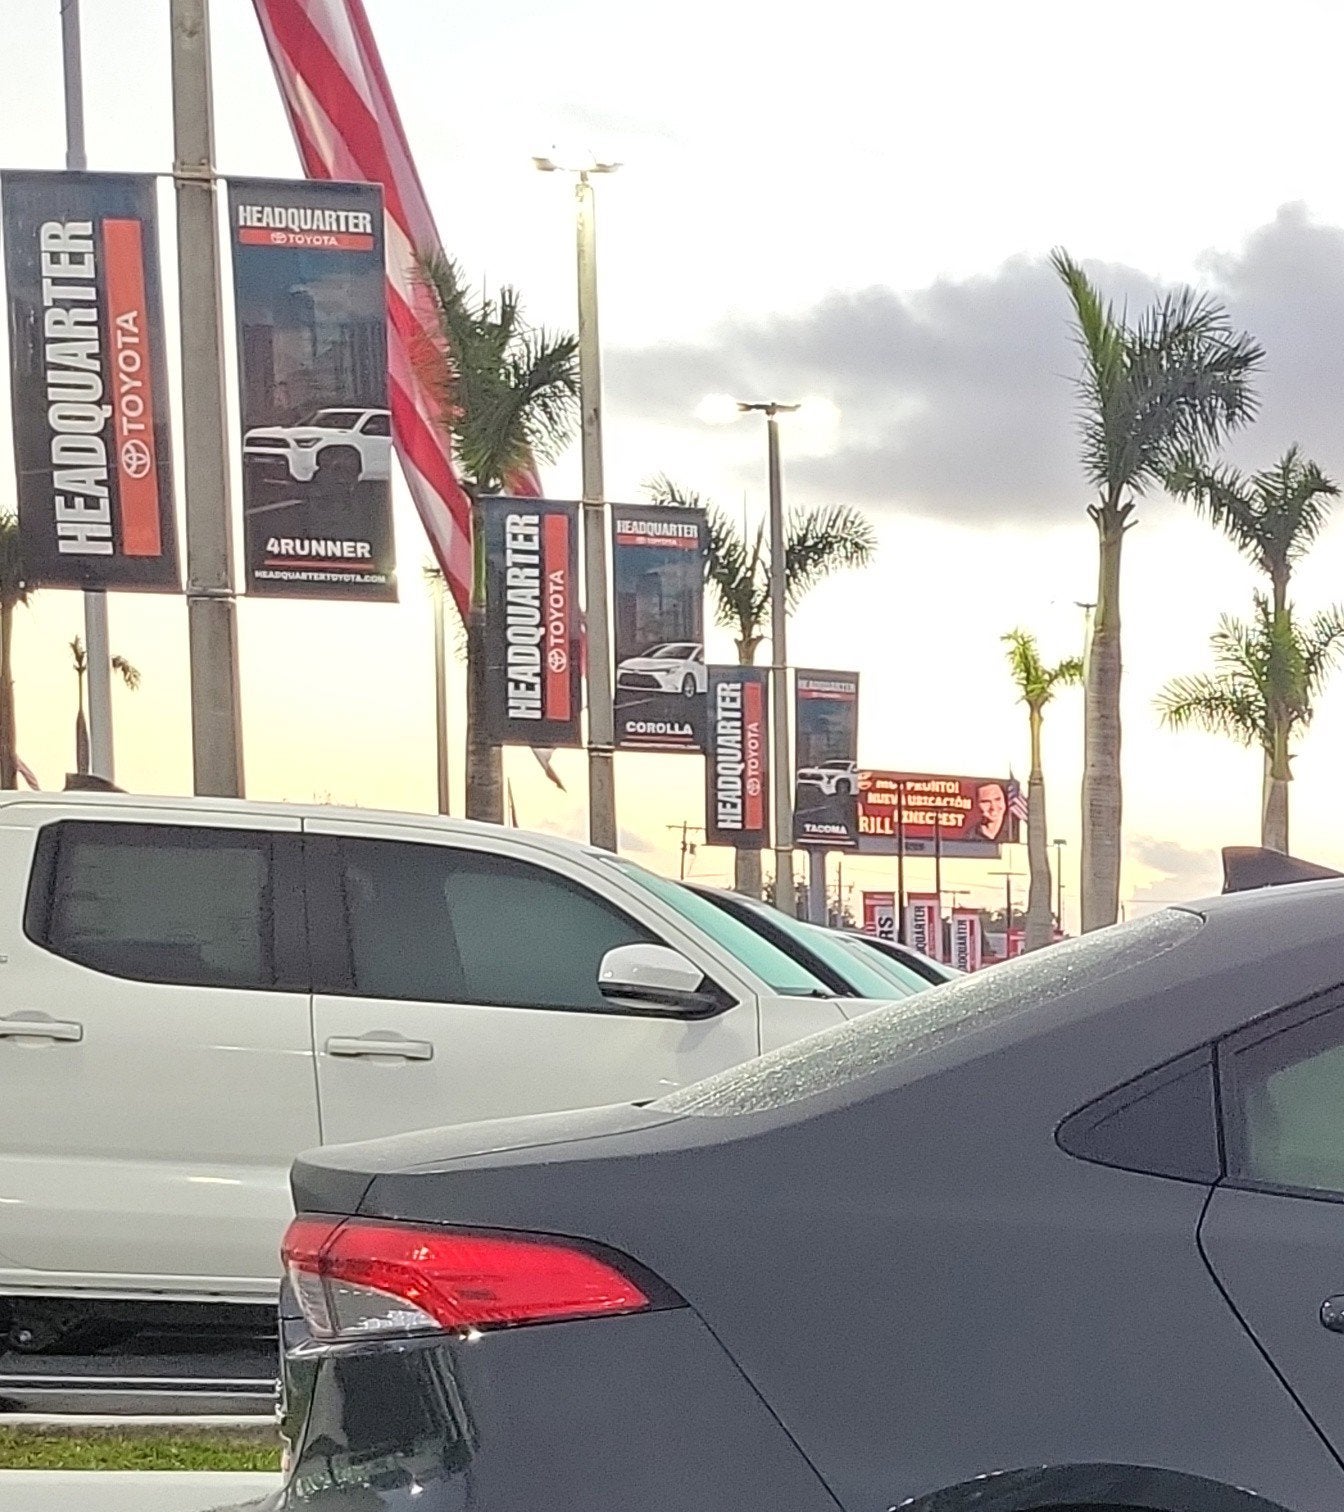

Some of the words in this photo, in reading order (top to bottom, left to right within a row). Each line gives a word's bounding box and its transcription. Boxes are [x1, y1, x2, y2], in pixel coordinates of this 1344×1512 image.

[239, 205, 372, 233] HEADQUARTER
[288, 233, 338, 246] TOYOTA
[116, 310, 146, 436] TOYOTA
[40, 221, 114, 556] HEADQUARTER
[616, 520, 698, 538] HEADQUARTER
[266, 538, 372, 558] 4RUNNER
[254, 570, 387, 584] HEADQUARTERTOYOTA.COM
[506, 513, 545, 719] HEADQUARTER
[550, 570, 564, 645] TOYOTA
[626, 721, 693, 735] COROLLA
[717, 682, 745, 829] HEADQUARTER
[748, 723, 759, 777] TOYOTA
[804, 823, 848, 834] TACOMA
